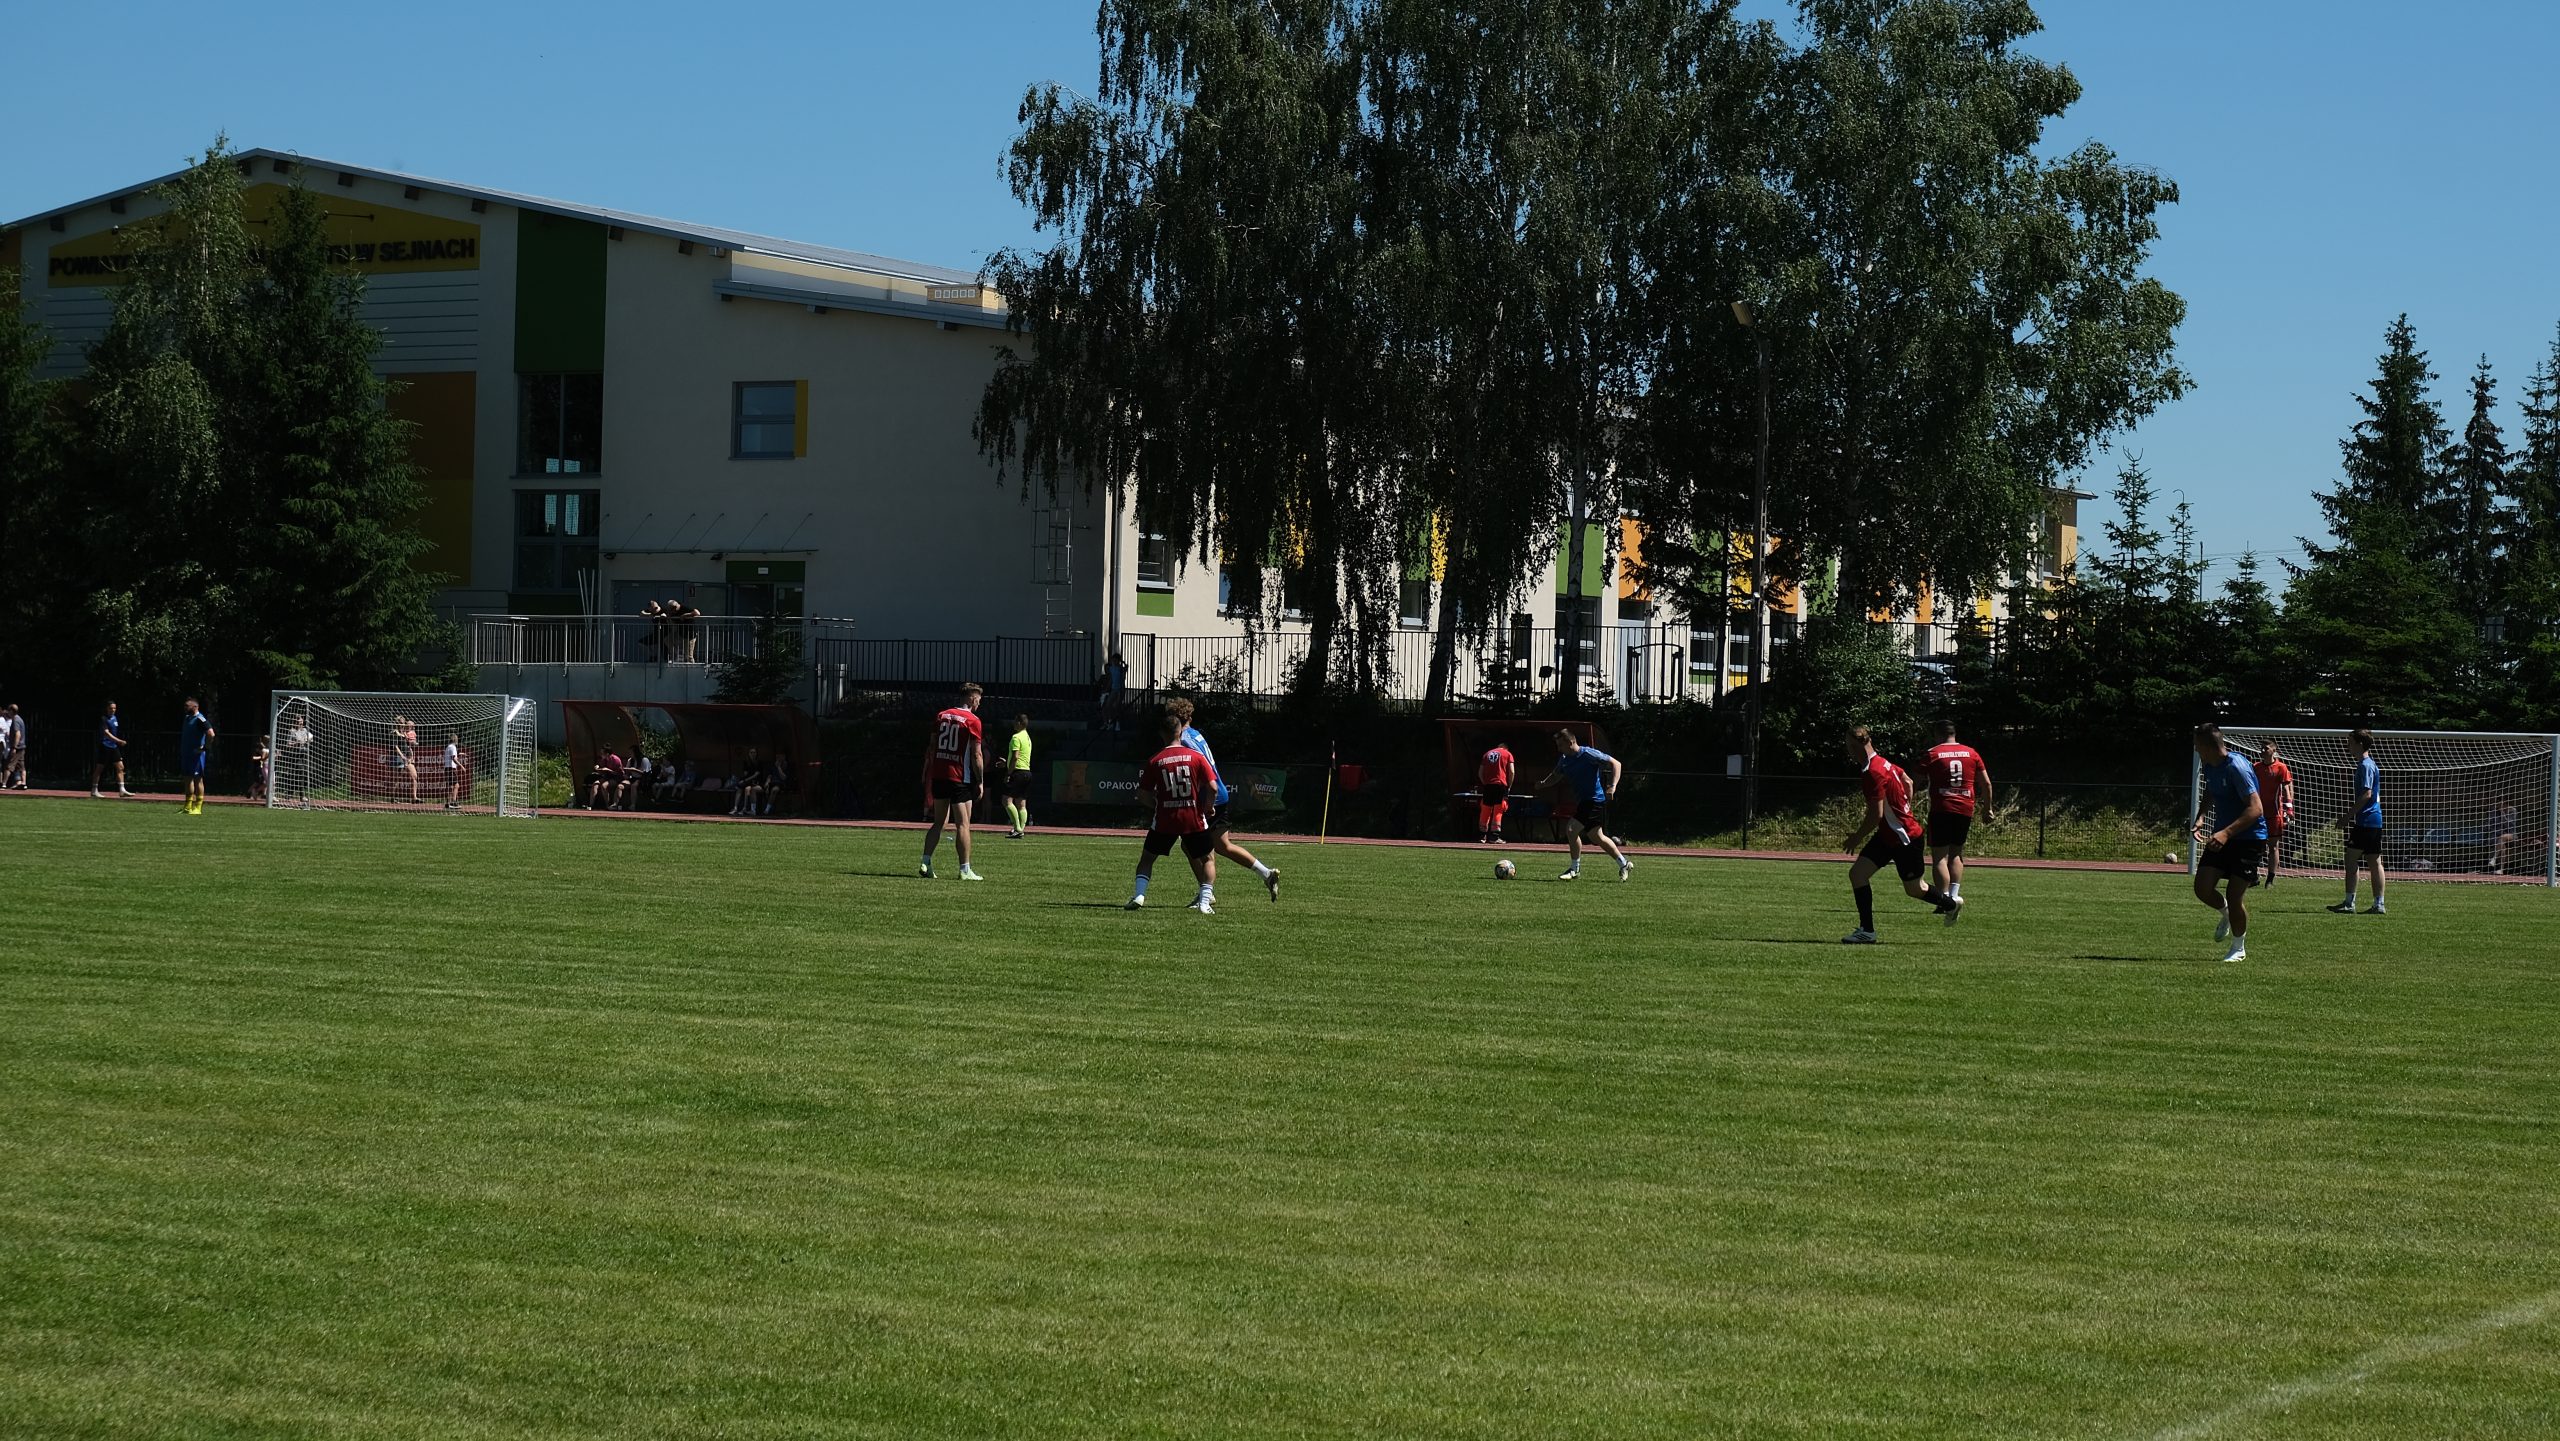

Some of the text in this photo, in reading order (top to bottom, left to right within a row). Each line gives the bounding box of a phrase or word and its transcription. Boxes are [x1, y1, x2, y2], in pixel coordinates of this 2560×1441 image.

[379, 238, 475, 261] SEJNACH
[938, 721, 960, 752] 20
[1161, 765, 1191, 798] 45
[1949, 759, 1963, 787] 9
